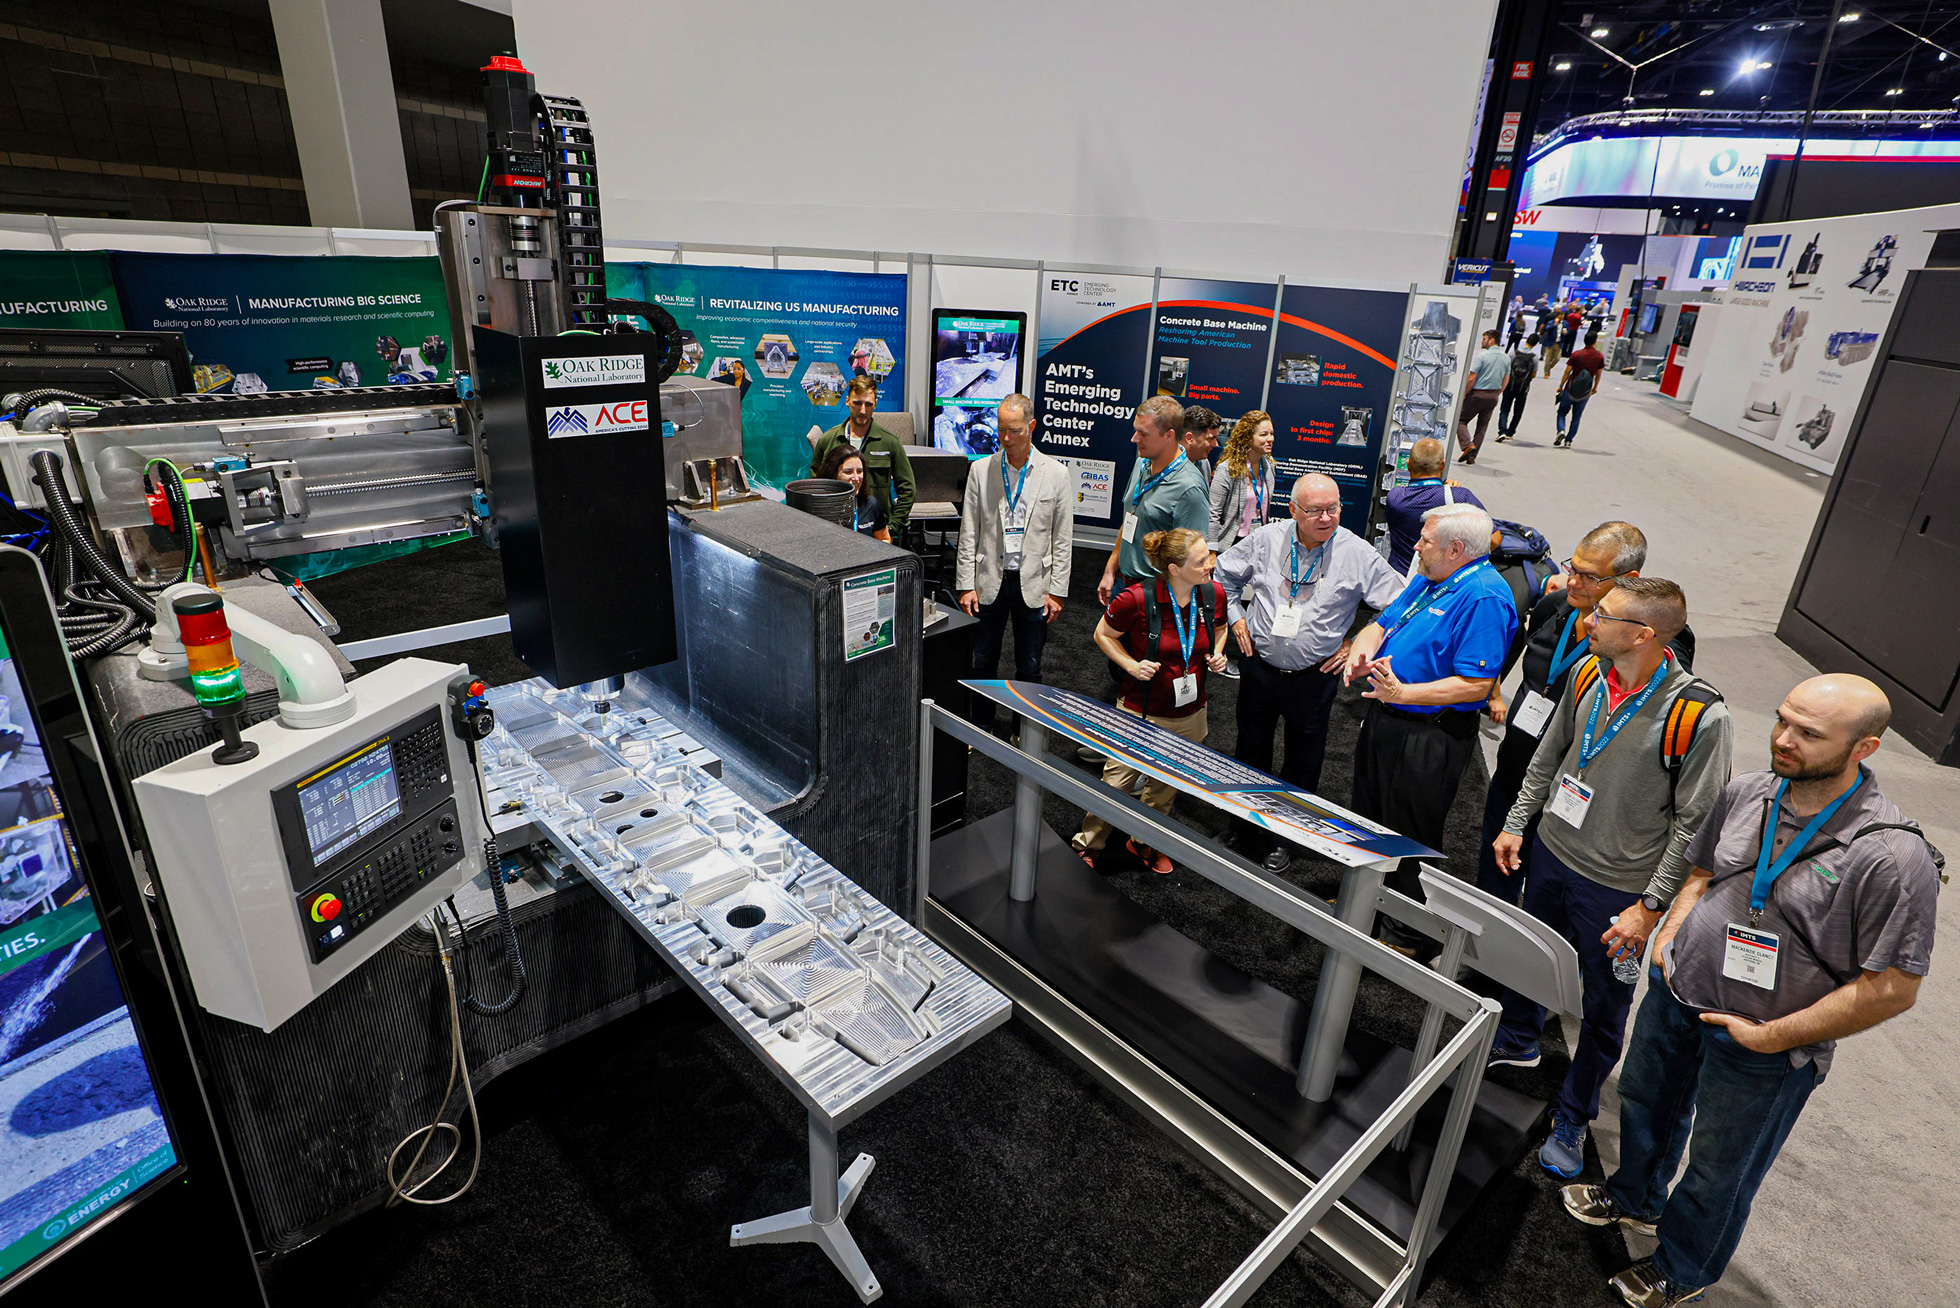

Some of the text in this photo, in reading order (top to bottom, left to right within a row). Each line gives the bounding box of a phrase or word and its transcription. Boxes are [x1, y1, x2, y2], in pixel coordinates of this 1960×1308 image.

[1458, 264, 1490, 272] VERICUT
[1051, 280, 1079, 292] ETC
[0, 300, 108, 314] UFACTURING
[175, 297, 228, 306] OAK RIDGE
[248, 294, 421, 309] MANUFACTURING BIG SCIENCE
[710, 298, 899, 316] REVITALIZING US MANUFACTURING
[154, 319, 188, 328] Building
[333, 313, 362, 321] research
[696, 314, 723, 322] Improving
[1160, 316, 1267, 331] Concrete Base Machine
[1159, 326, 1235, 338] Reshoring American
[1158, 336, 1189, 344] Machine
[1209, 339, 1252, 349] Production
[562, 358, 643, 373] OAK RIDGE
[1045, 363, 1094, 379] AMT's
[1324, 362, 1346, 370] Rapid
[564, 373, 643, 383] National Laboratory
[1323, 371, 1356, 379] domestic
[1045, 381, 1121, 401] Emerging
[1321, 380, 1364, 388] production.
[595, 401, 648, 426] ACE
[1044, 397, 1135, 420] Technology
[1042, 414, 1094, 431] Center
[1041, 431, 1090, 448] Annex
[1640, 676, 1662, 706] IMTS2022
[1617, 712, 1631, 727] IMTS+
[1740, 932, 1756, 941] IMTS
[0, 932, 46, 958] IES.
[1731, 944, 1755, 955] MACKENZIE
[1756, 951, 1774, 960] CLANCY
[137, 1150, 168, 1173] Office of
[139, 1158, 168, 1179] Science
[68, 1178, 130, 1226] ENERGY
